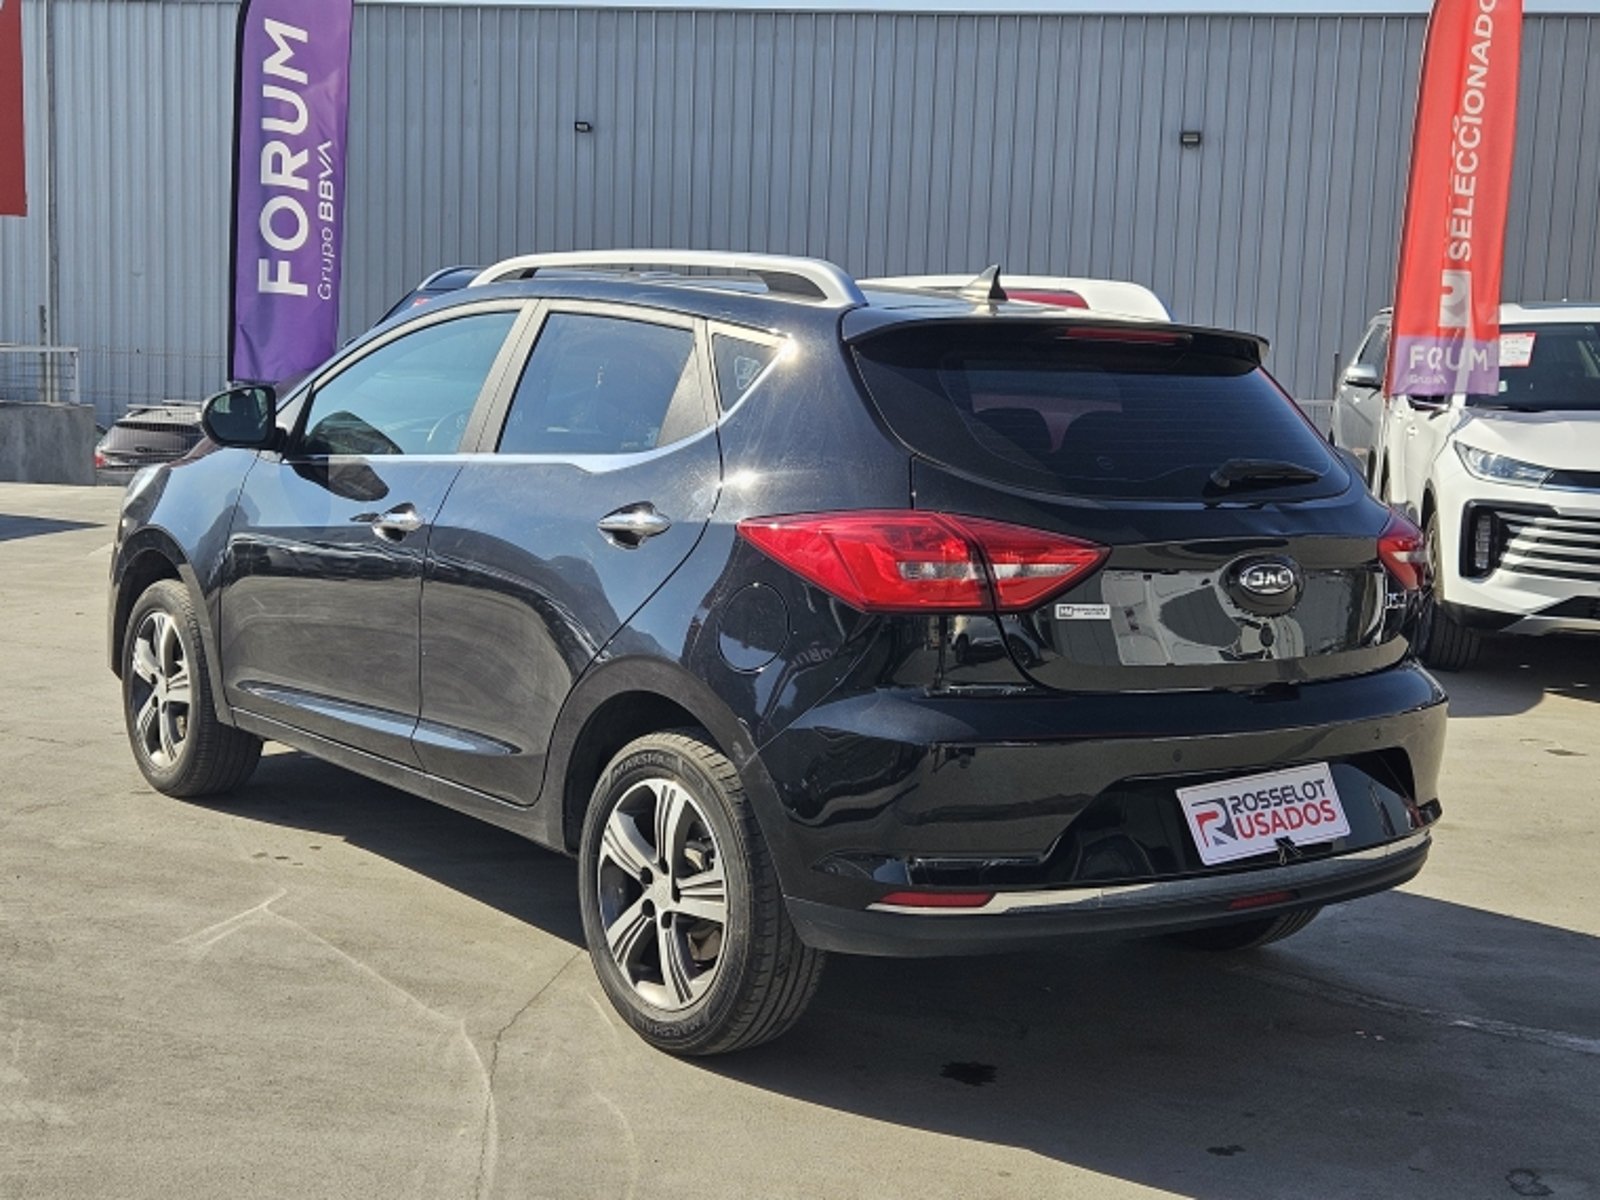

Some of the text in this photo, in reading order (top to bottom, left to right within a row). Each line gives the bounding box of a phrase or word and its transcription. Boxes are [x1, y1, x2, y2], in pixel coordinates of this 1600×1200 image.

[258, 17, 310, 297] FORUM
[317, 140, 334, 300] Grupo BBVA
[1228, 779, 1326, 815] ROSSELOT
[1235, 799, 1337, 840] USADOS
